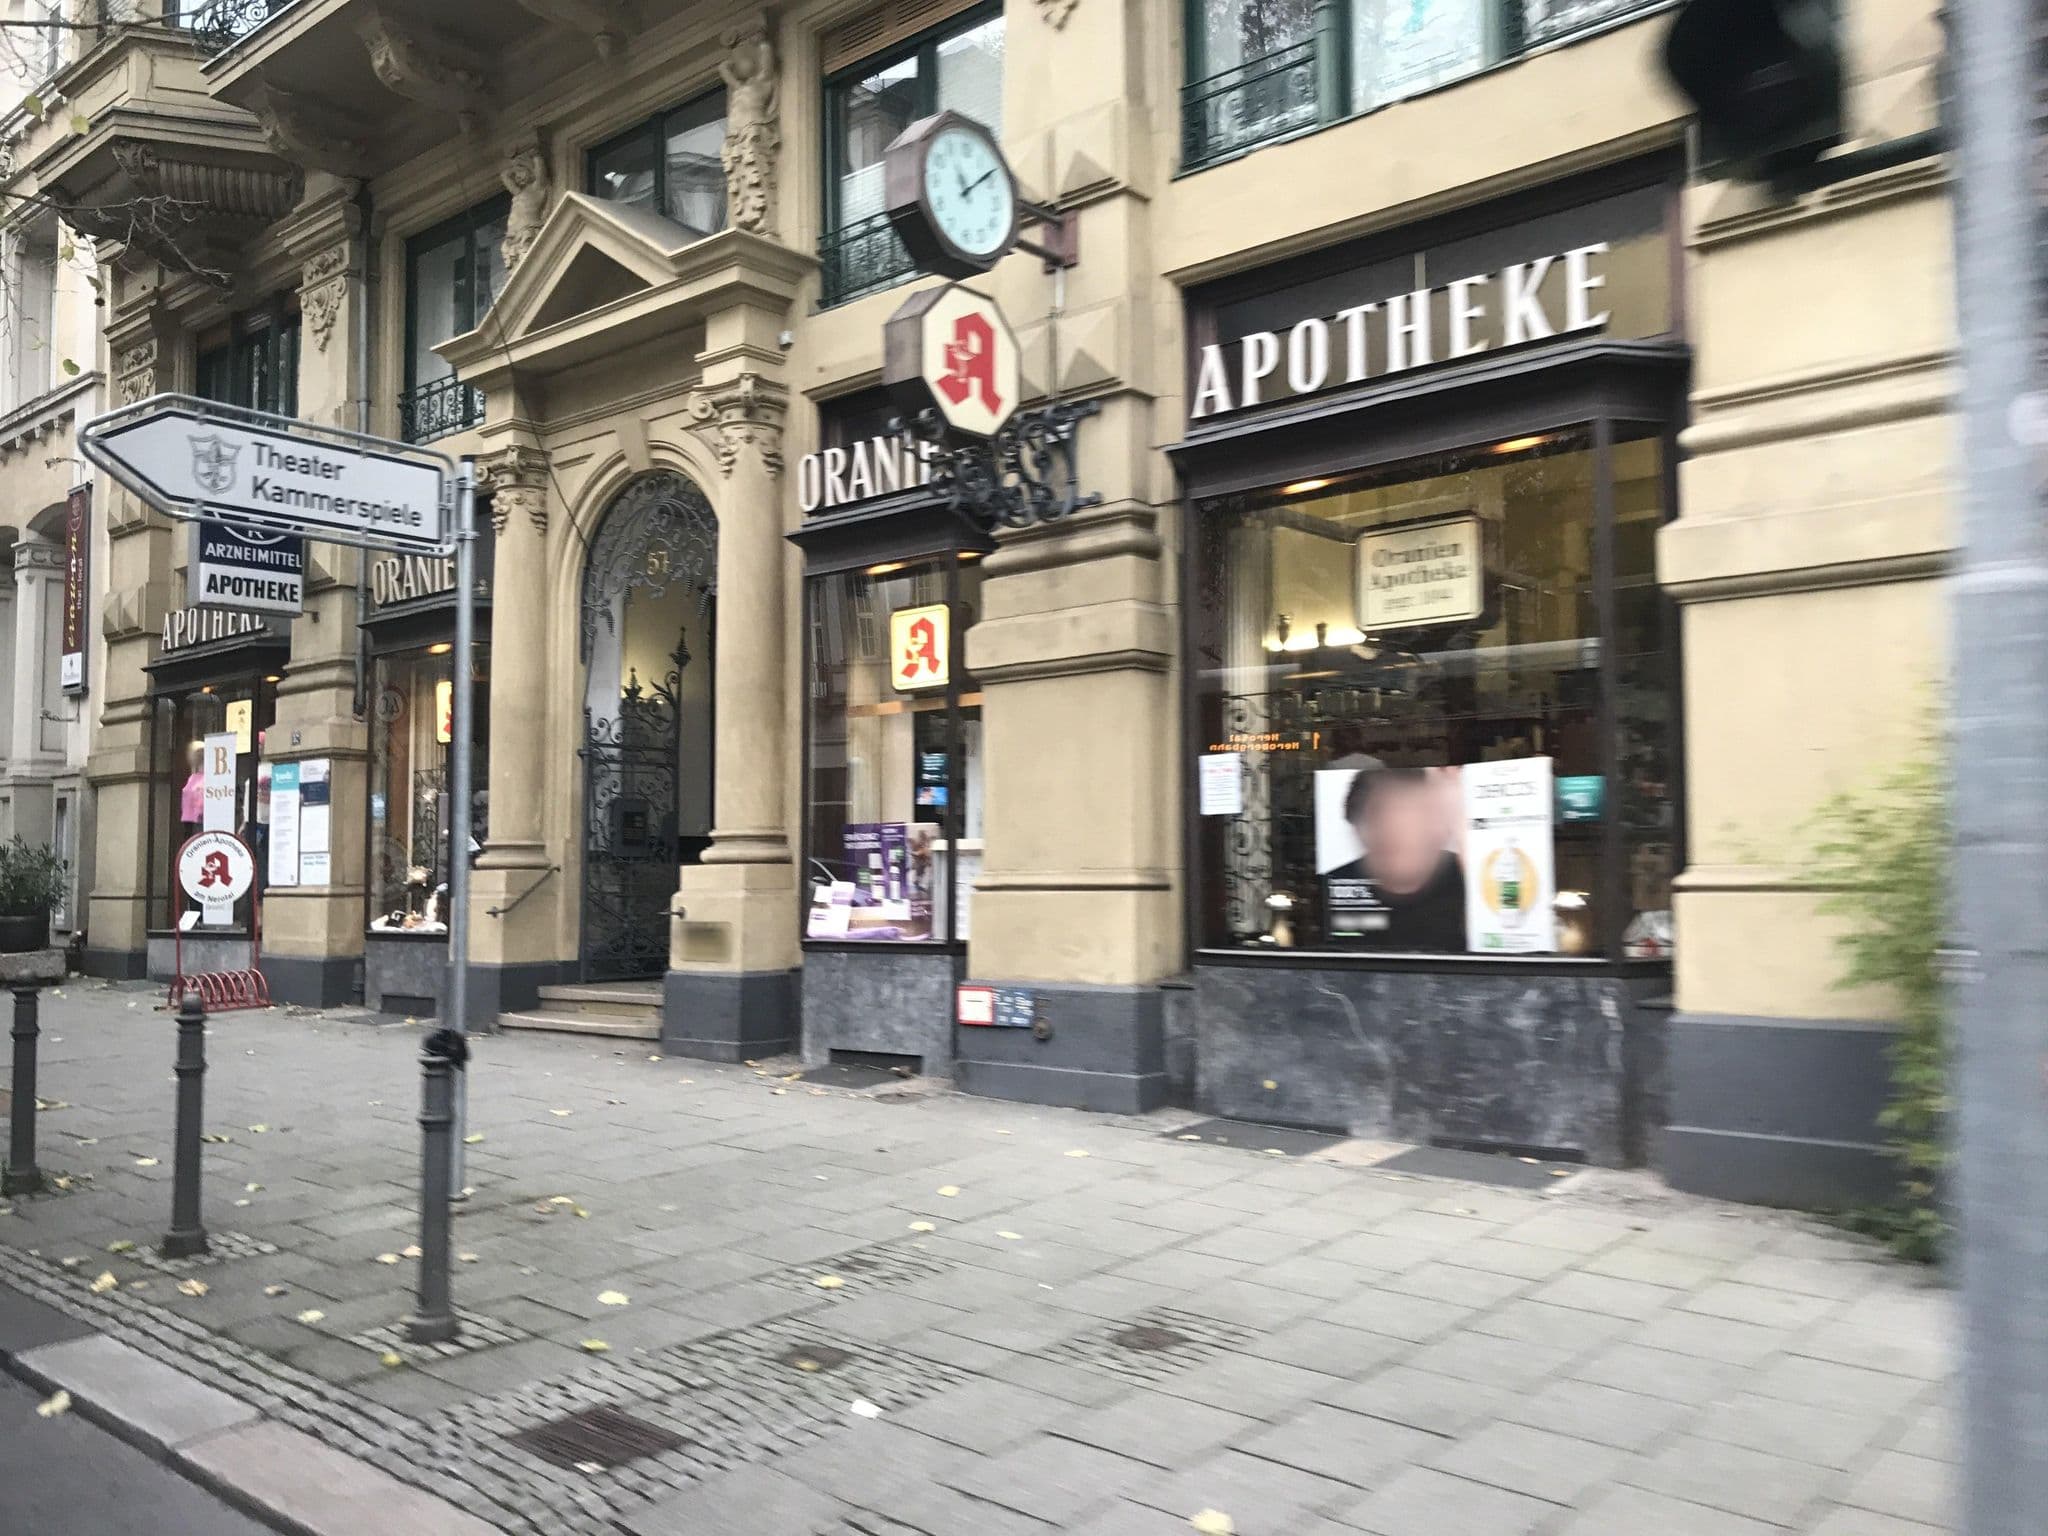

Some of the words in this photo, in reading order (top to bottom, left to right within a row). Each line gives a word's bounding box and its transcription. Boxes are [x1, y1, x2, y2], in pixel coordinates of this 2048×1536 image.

[1190, 242, 1612, 418] APOTHEKE
[251, 441, 347, 480] Theater
[251, 476, 422, 527] Kammerspiele
[205, 542, 302, 568] ARZNEIMITTEL
[206, 573, 299, 603] APOTHEKE
[213, 746, 232, 776] B.
[206, 784, 234, 801] Style
[193, 890, 206, 900] am
